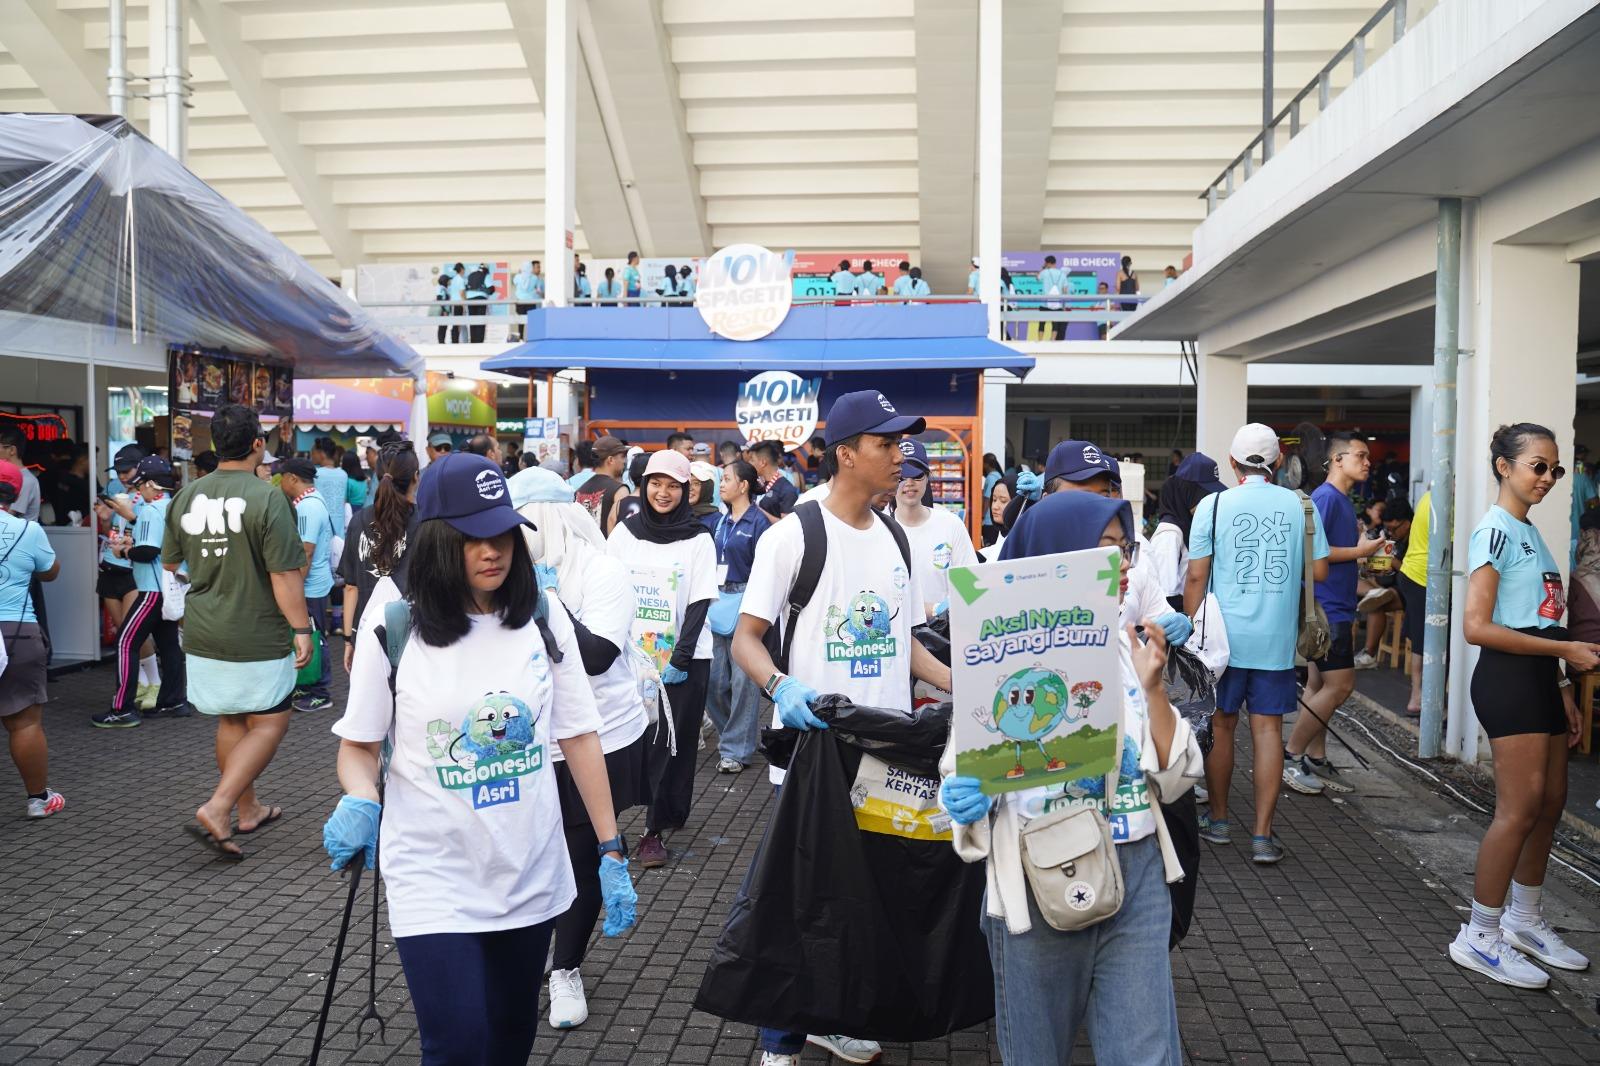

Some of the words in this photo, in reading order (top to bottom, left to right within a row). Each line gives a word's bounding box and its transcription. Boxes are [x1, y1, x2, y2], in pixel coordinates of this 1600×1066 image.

[699, 249, 796, 288] WOW
[1063, 258, 1080, 266] BIB
[1081, 258, 1116, 266] CHECK
[699, 285, 785, 309] SPAGETI
[293, 389, 335, 410] ndr
[738, 377, 822, 408] WOW
[738, 407, 812, 424] SPAGETI
[748, 424, 804, 442] Resto
[1235, 549, 1290, 584] 25
[645, 610, 670, 620] ASRI
[980, 609, 1027, 641] Aksi
[1029, 606, 1095, 630] Nyata
[829, 638, 894, 659] Indonesia
[964, 630, 1052, 666] Sayangi
[1053, 625, 1109, 647] Bumi
[853, 660, 879, 675] Asri
[441, 751, 541, 786] Indonesia
[886, 765, 941, 788] SAMPAH
[477, 780, 515, 804] Asri
[885, 778, 937, 800] KERTAS
[1110, 817, 1125, 835] ri
